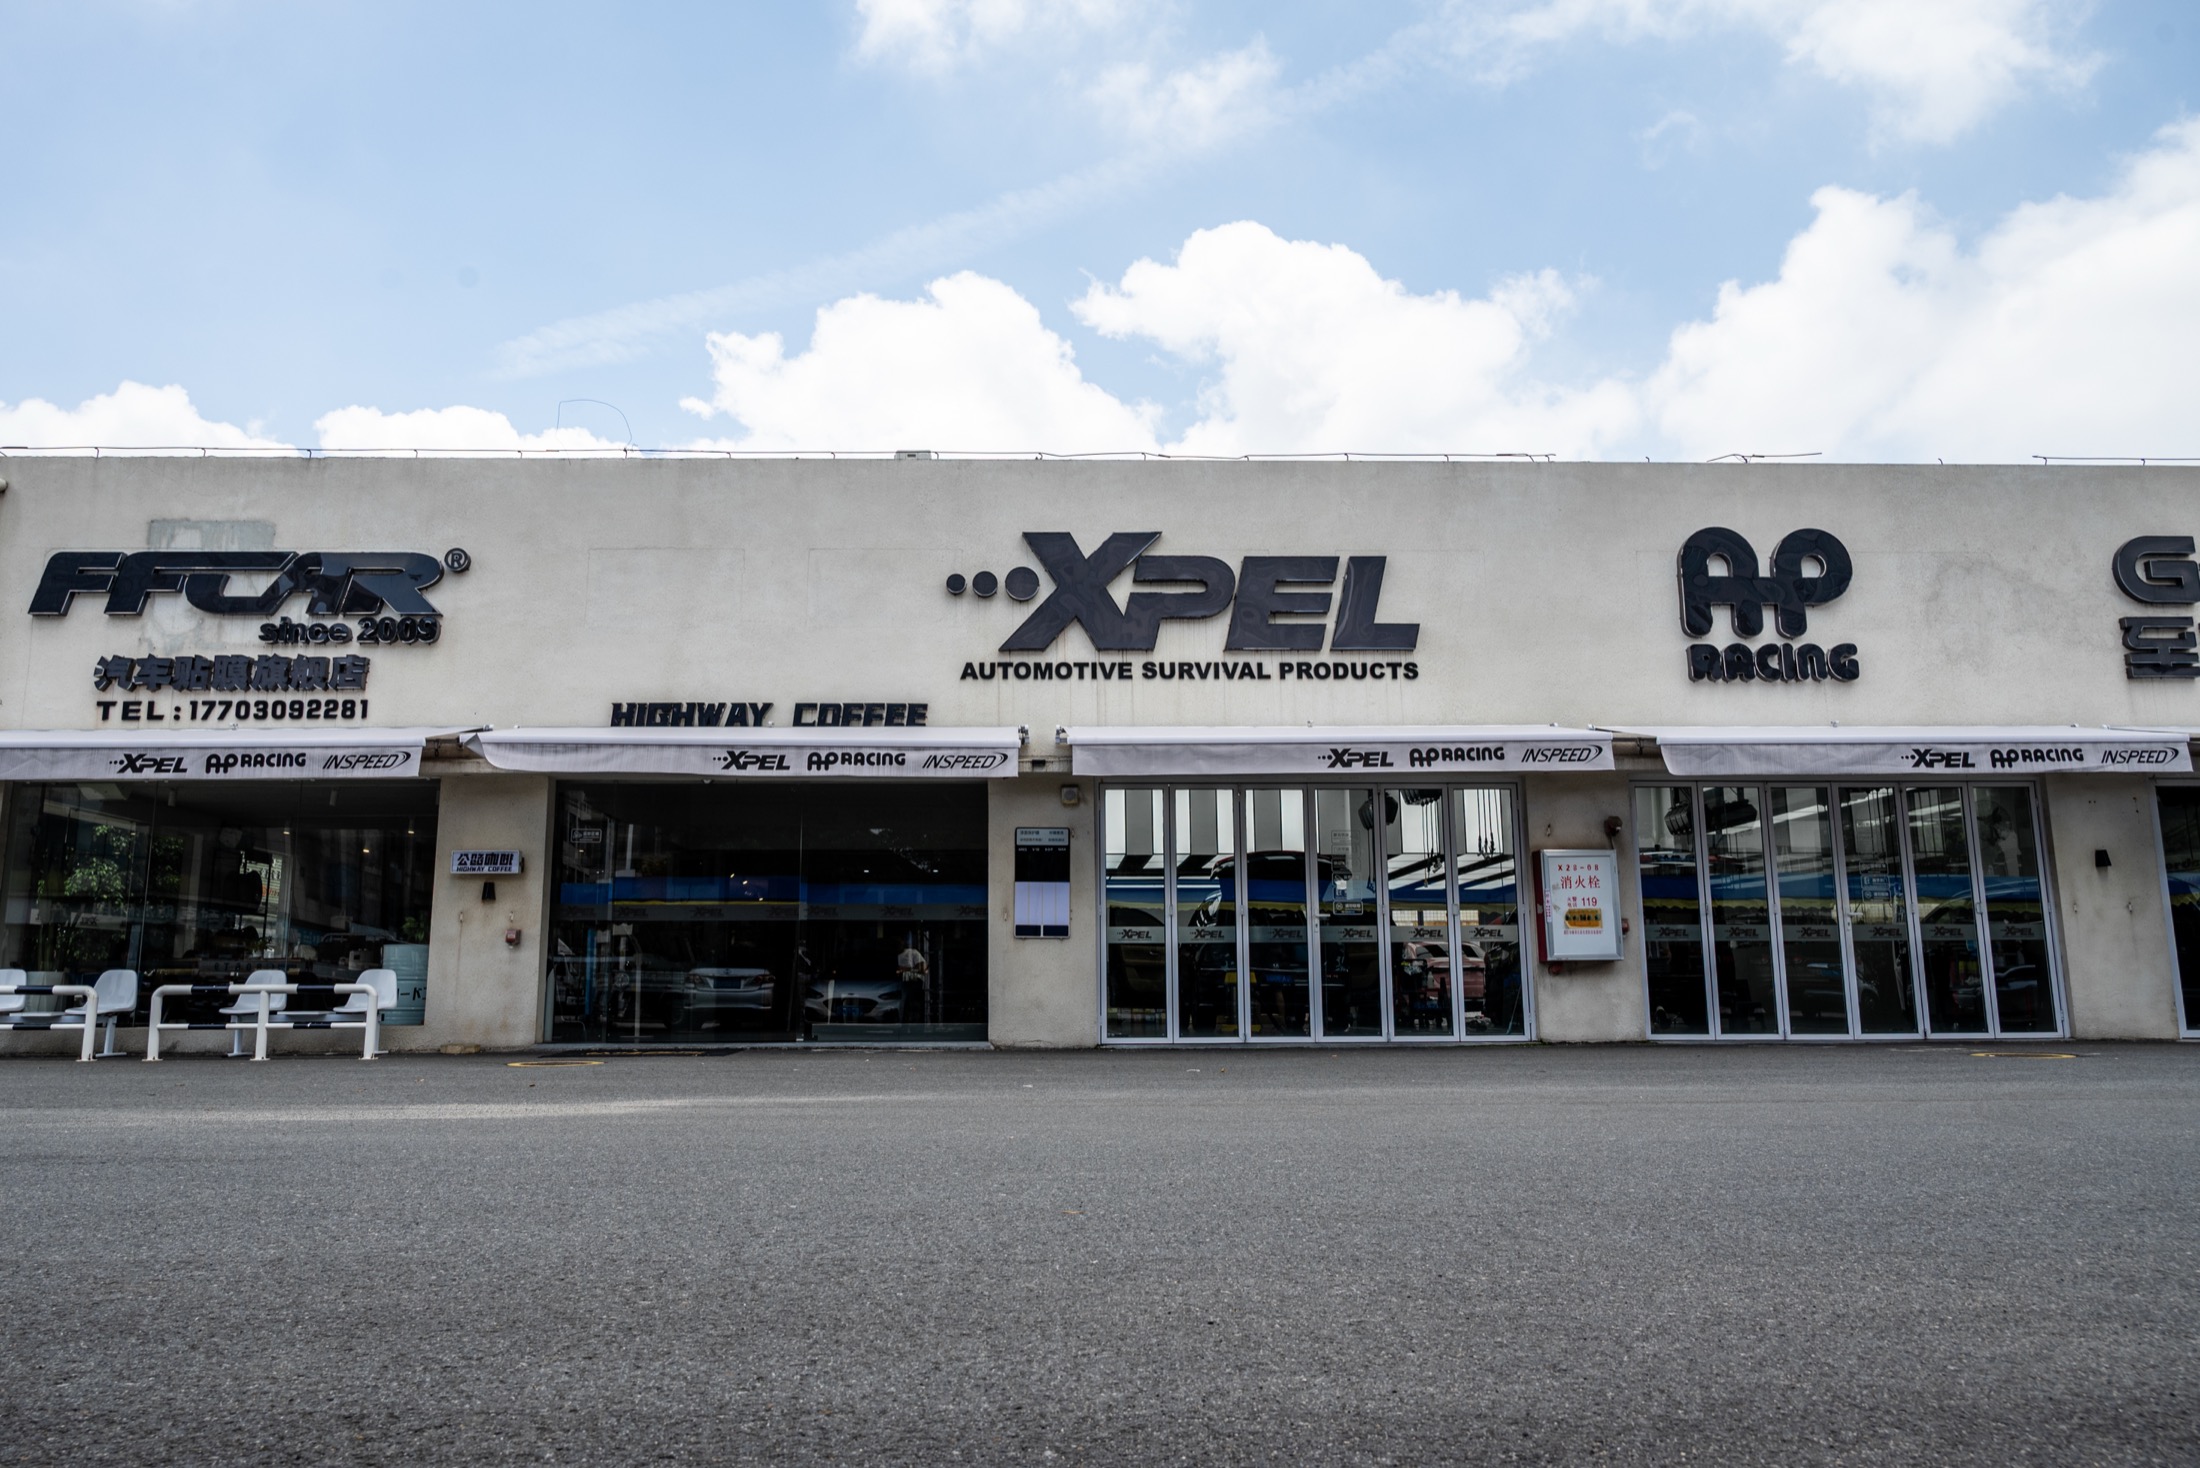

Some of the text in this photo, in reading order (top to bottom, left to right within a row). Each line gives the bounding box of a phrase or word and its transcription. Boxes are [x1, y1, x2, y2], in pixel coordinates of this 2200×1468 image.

[2112, 535, 2200, 605] G
[1676, 526, 1853, 638] AP
[999, 531, 1420, 652] XPEL
[258, 616, 442, 646] since 2009
[1686, 642, 1860, 683] RACING
[94, 653, 371, 693] 汽车贴膜旗舰店
[960, 661, 1419, 681] AUTOMOTIVE SURVIVAL PRODUCTS
[611, 702, 929, 728] HIGHWAY COFFEE
[117, 753, 188, 773] XPEL
[241, 752, 306, 768] RACING
[322, 754, 399, 770] INSPEED
[721, 750, 791, 770] XPEL
[841, 752, 906, 767] RACING
[922, 754, 996, 769] INSPEED
[1327, 748, 1394, 768] XPEL
[1441, 746, 1505, 762] RACING
[1521, 748, 1590, 763] INSPEED
[1911, 748, 1976, 768] XPEL
[2021, 748, 2084, 763] RACING
[2101, 750, 2167, 765] INSPEED
[457, 852, 514, 866] 公路咖啡
[1560, 875, 1601, 889] 消火栓
[1581, 897, 1598, 907] 119
[1121, 928, 1152, 939] XPEL
[1195, 928, 1224, 939] XPEL
[1273, 928, 1303, 938] XPEL
[1343, 927, 1373, 938] XPEL
[1414, 927, 1443, 937] XPEL
[1474, 927, 1504, 937] XPEL
[1659, 926, 1688, 937] XPEL
[1730, 926, 1759, 937] XPEL
[1801, 926, 1831, 937] XPEL
[1873, 926, 1902, 937] XPEL
[1934, 926, 1964, 937] XPEL
[2005, 926, 2035, 936] XPEL
